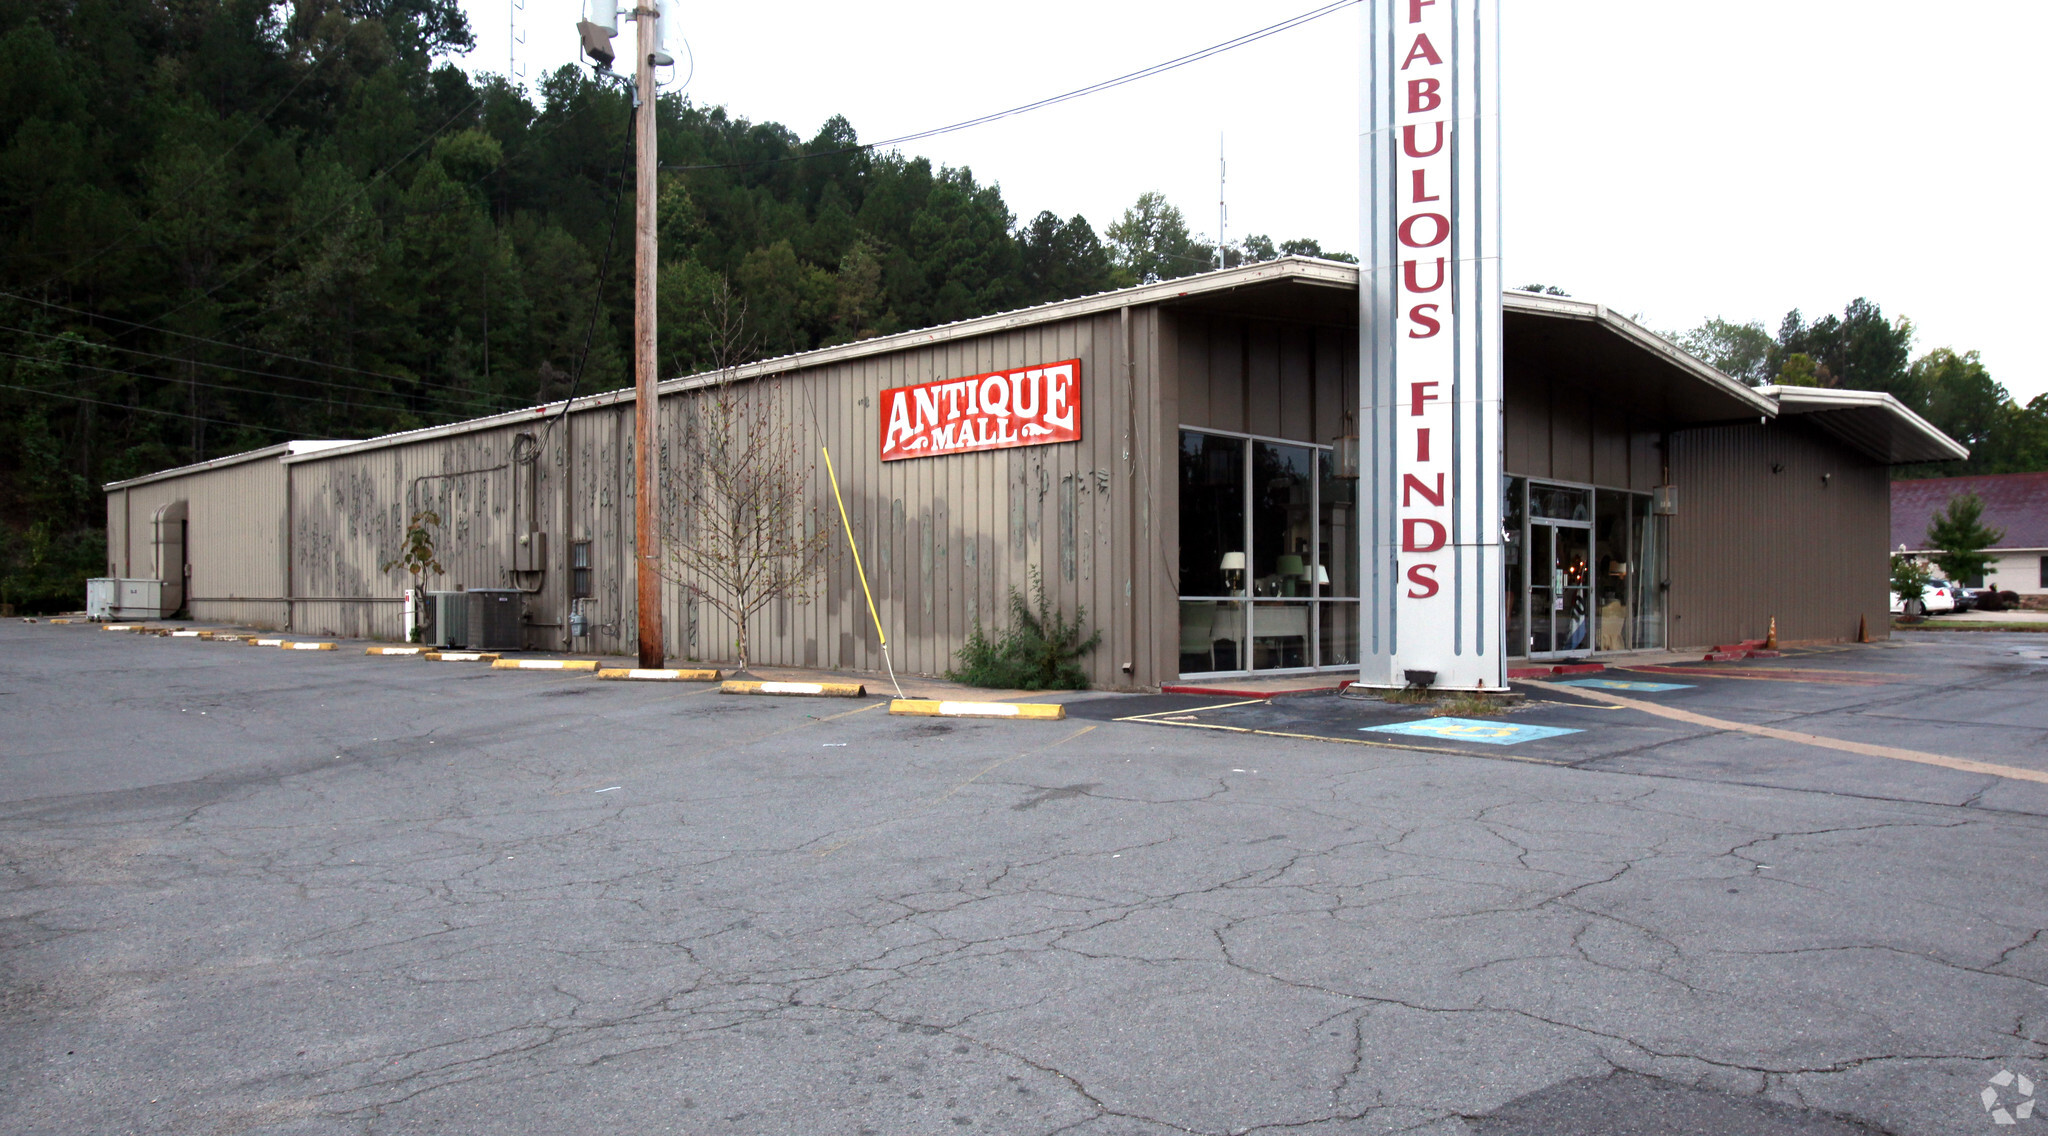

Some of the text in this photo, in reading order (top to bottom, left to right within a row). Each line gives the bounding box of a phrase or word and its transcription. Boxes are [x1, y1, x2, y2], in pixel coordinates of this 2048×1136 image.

[1398, 0, 1450, 598] FABULOUS FINDS
[883, 364, 1074, 454] ANTIQUE
[931, 417, 1018, 450] MALL
